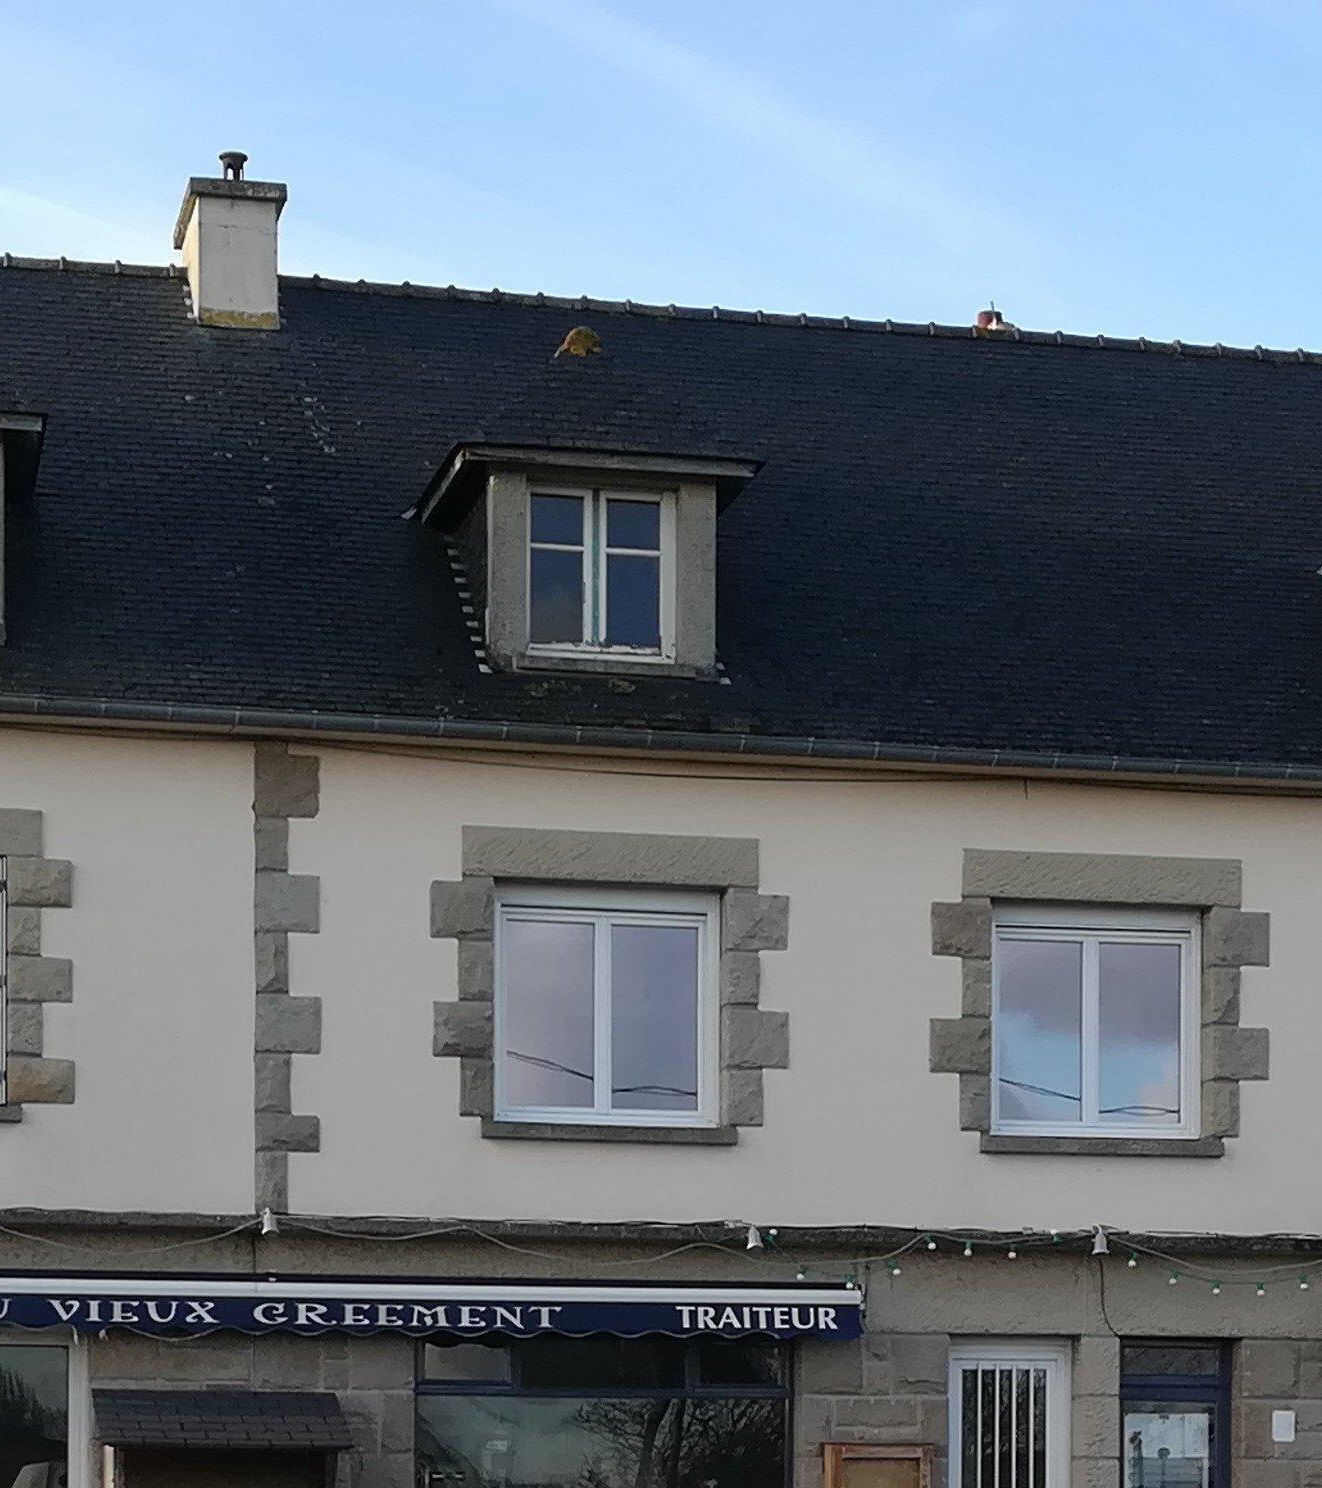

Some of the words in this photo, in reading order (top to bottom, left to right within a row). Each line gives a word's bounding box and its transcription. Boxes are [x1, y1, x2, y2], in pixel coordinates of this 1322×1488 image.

[48, 1299, 220, 1324] VIEUX
[253, 1301, 562, 1330] GREEMENT
[675, 1305, 839, 1330] TRAITEUR
